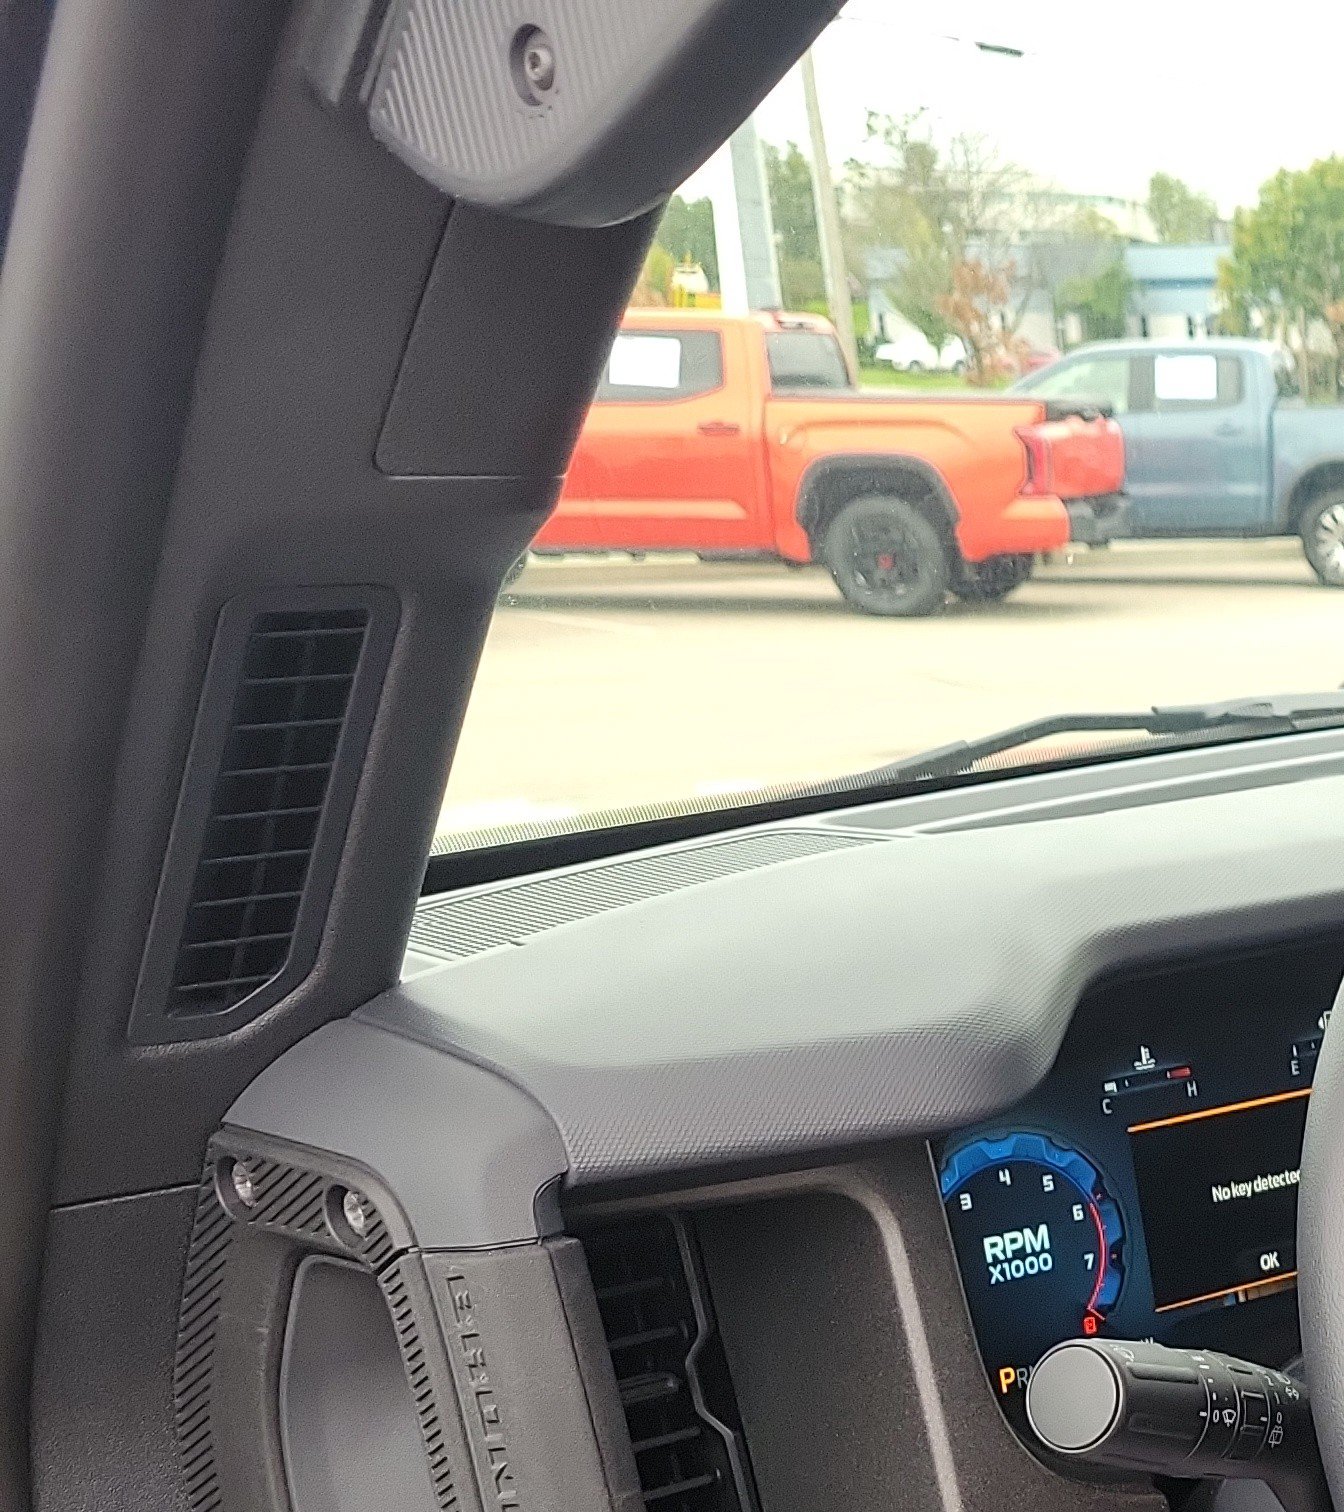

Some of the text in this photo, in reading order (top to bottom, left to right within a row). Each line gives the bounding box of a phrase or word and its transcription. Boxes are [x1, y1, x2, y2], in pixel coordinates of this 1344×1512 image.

[1186, 1080, 1198, 1097] H
[1102, 1098, 1113, 1115] C
[999, 1168, 1011, 1186] 4
[1042, 1174, 1055, 1192] 5
[1211, 1184, 1231, 1203] No
[1230, 1180, 1253, 1199] key
[959, 1192, 972, 1211] 3
[1072, 1204, 1084, 1221] 6
[983, 1223, 1051, 1264] RPM
[988, 1252, 1053, 1285] X1000
[1083, 1253, 1095, 1270] 7
[1259, 1251, 1280, 1271] OK
